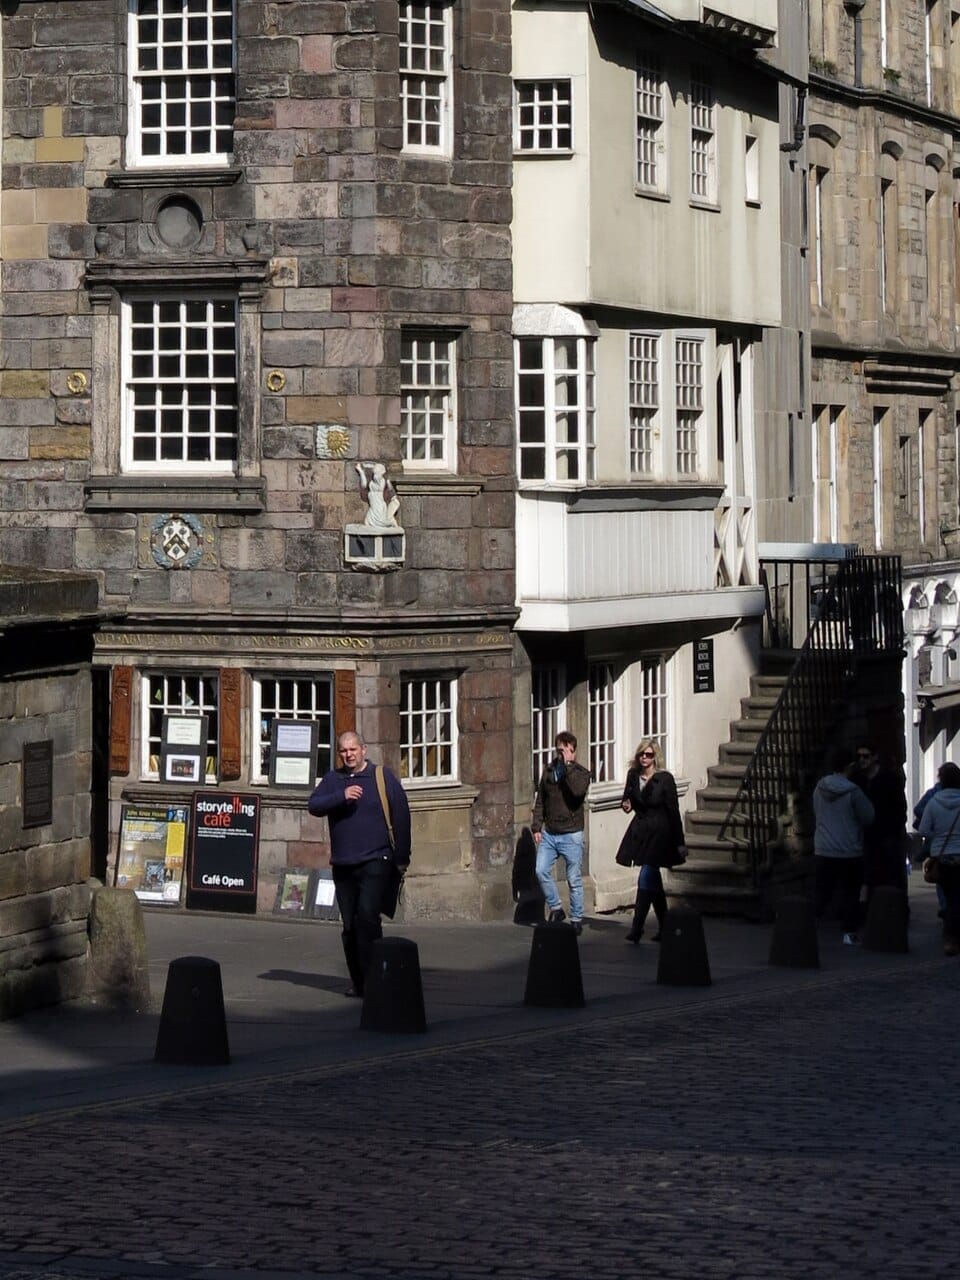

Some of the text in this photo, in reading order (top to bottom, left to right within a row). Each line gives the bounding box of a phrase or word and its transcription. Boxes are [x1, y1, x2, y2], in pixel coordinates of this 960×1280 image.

[197, 797, 256, 817] storytelling
[203, 811, 232, 828] café
[202, 874, 245, 888] Café Open
